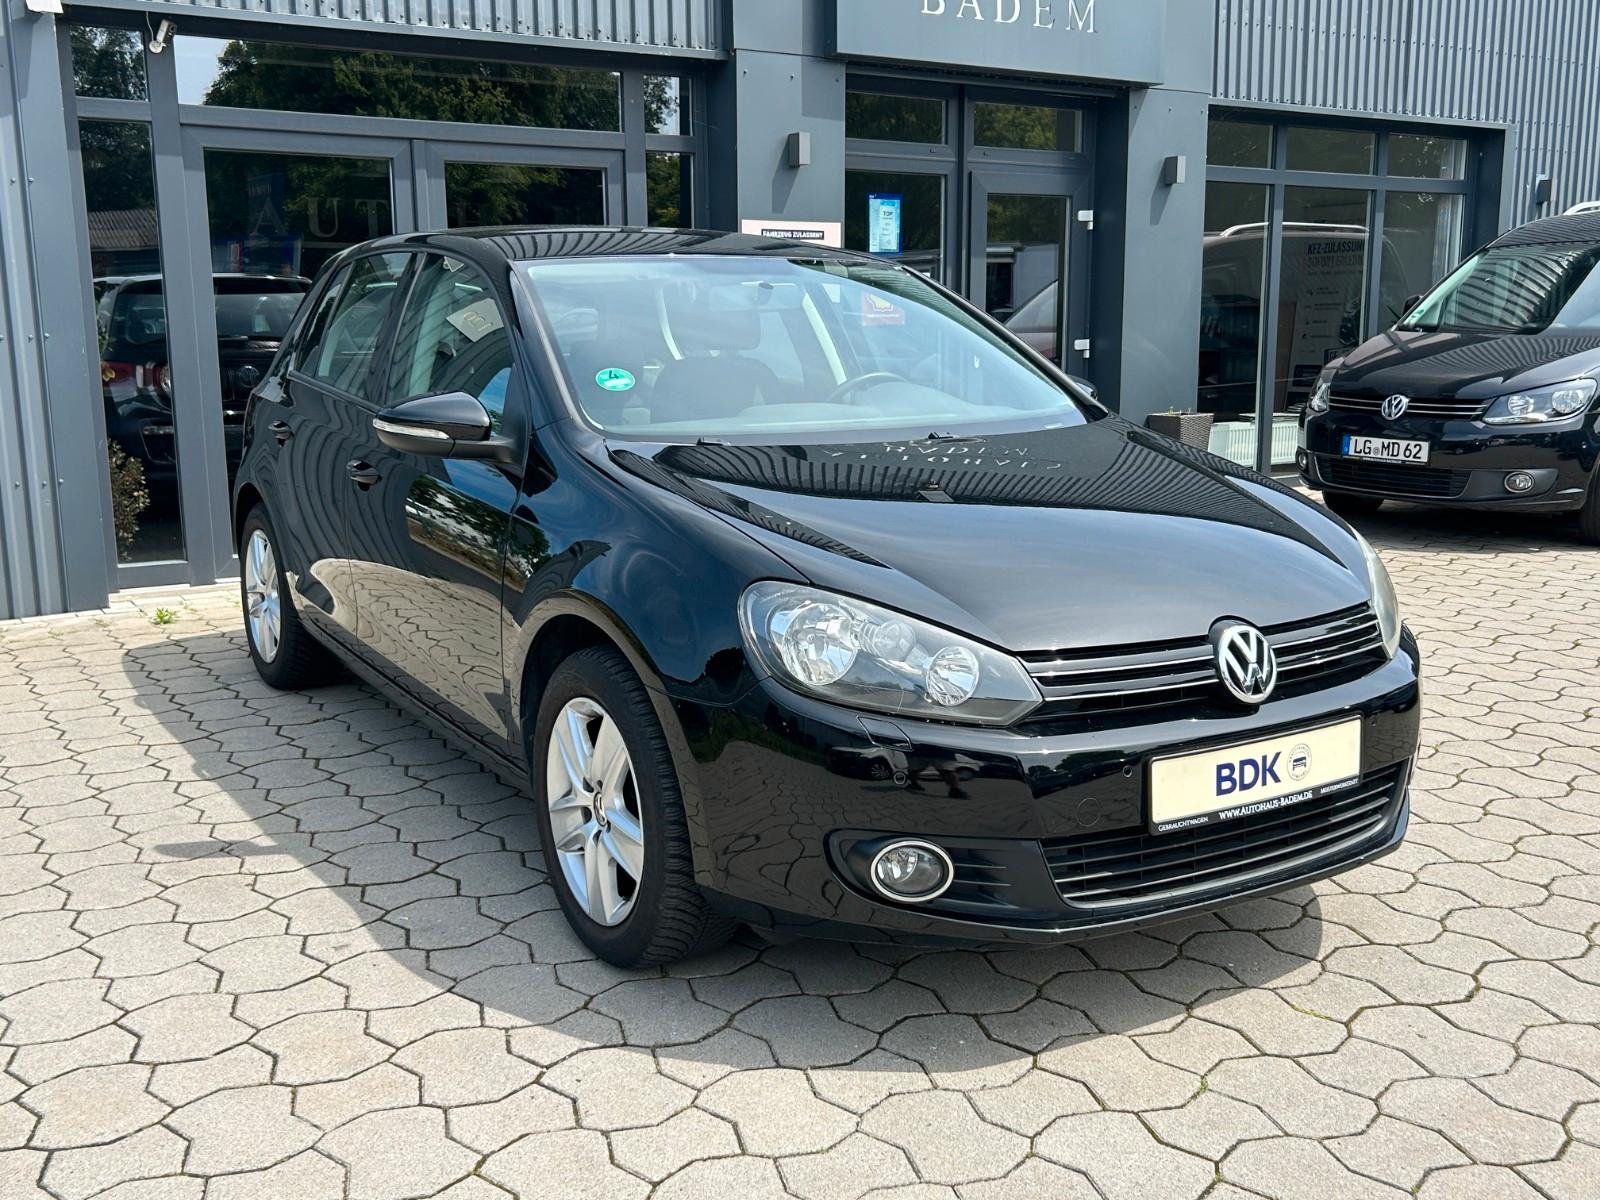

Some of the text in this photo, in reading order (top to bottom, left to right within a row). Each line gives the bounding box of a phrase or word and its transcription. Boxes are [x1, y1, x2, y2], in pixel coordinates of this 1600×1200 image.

[1307, 240, 1365, 255] KFZ-ZULASSUN
[608, 370, 620, 379] 4
[1353, 438, 1422, 459] LG MD 62
[1216, 751, 1281, 796] BDK
[1158, 816, 1209, 832] GEBRAUCHTWAGEN
